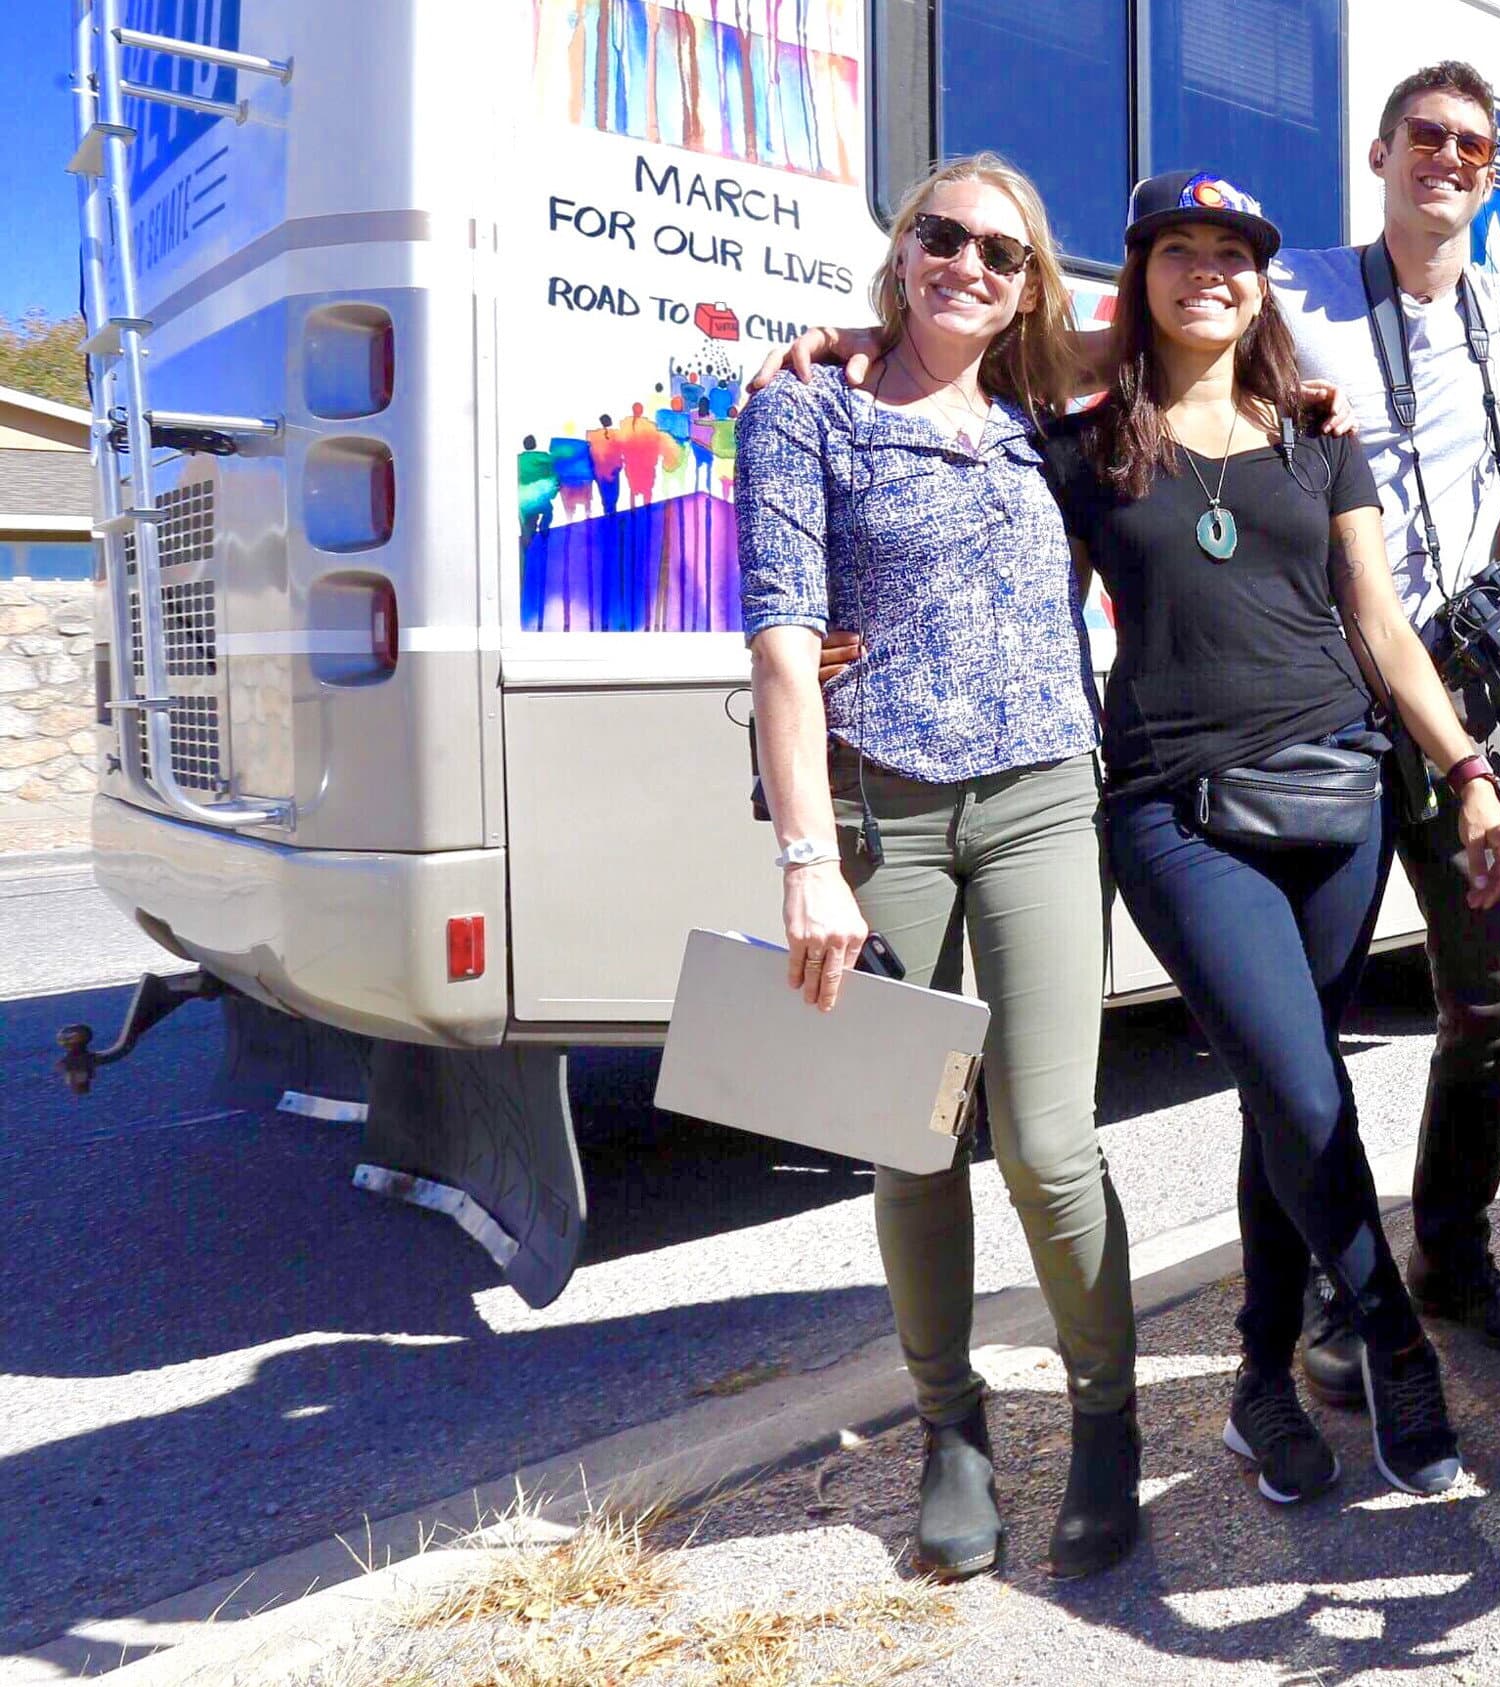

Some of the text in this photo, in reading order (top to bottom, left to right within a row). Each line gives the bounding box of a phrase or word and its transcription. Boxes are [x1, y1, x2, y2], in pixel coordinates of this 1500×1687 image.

[636, 155, 800, 230] MARCH
[550, 196, 854, 294] FOR OUR LIVES
[548, 277, 640, 316] ROAD
[649, 296, 690, 325] TO
